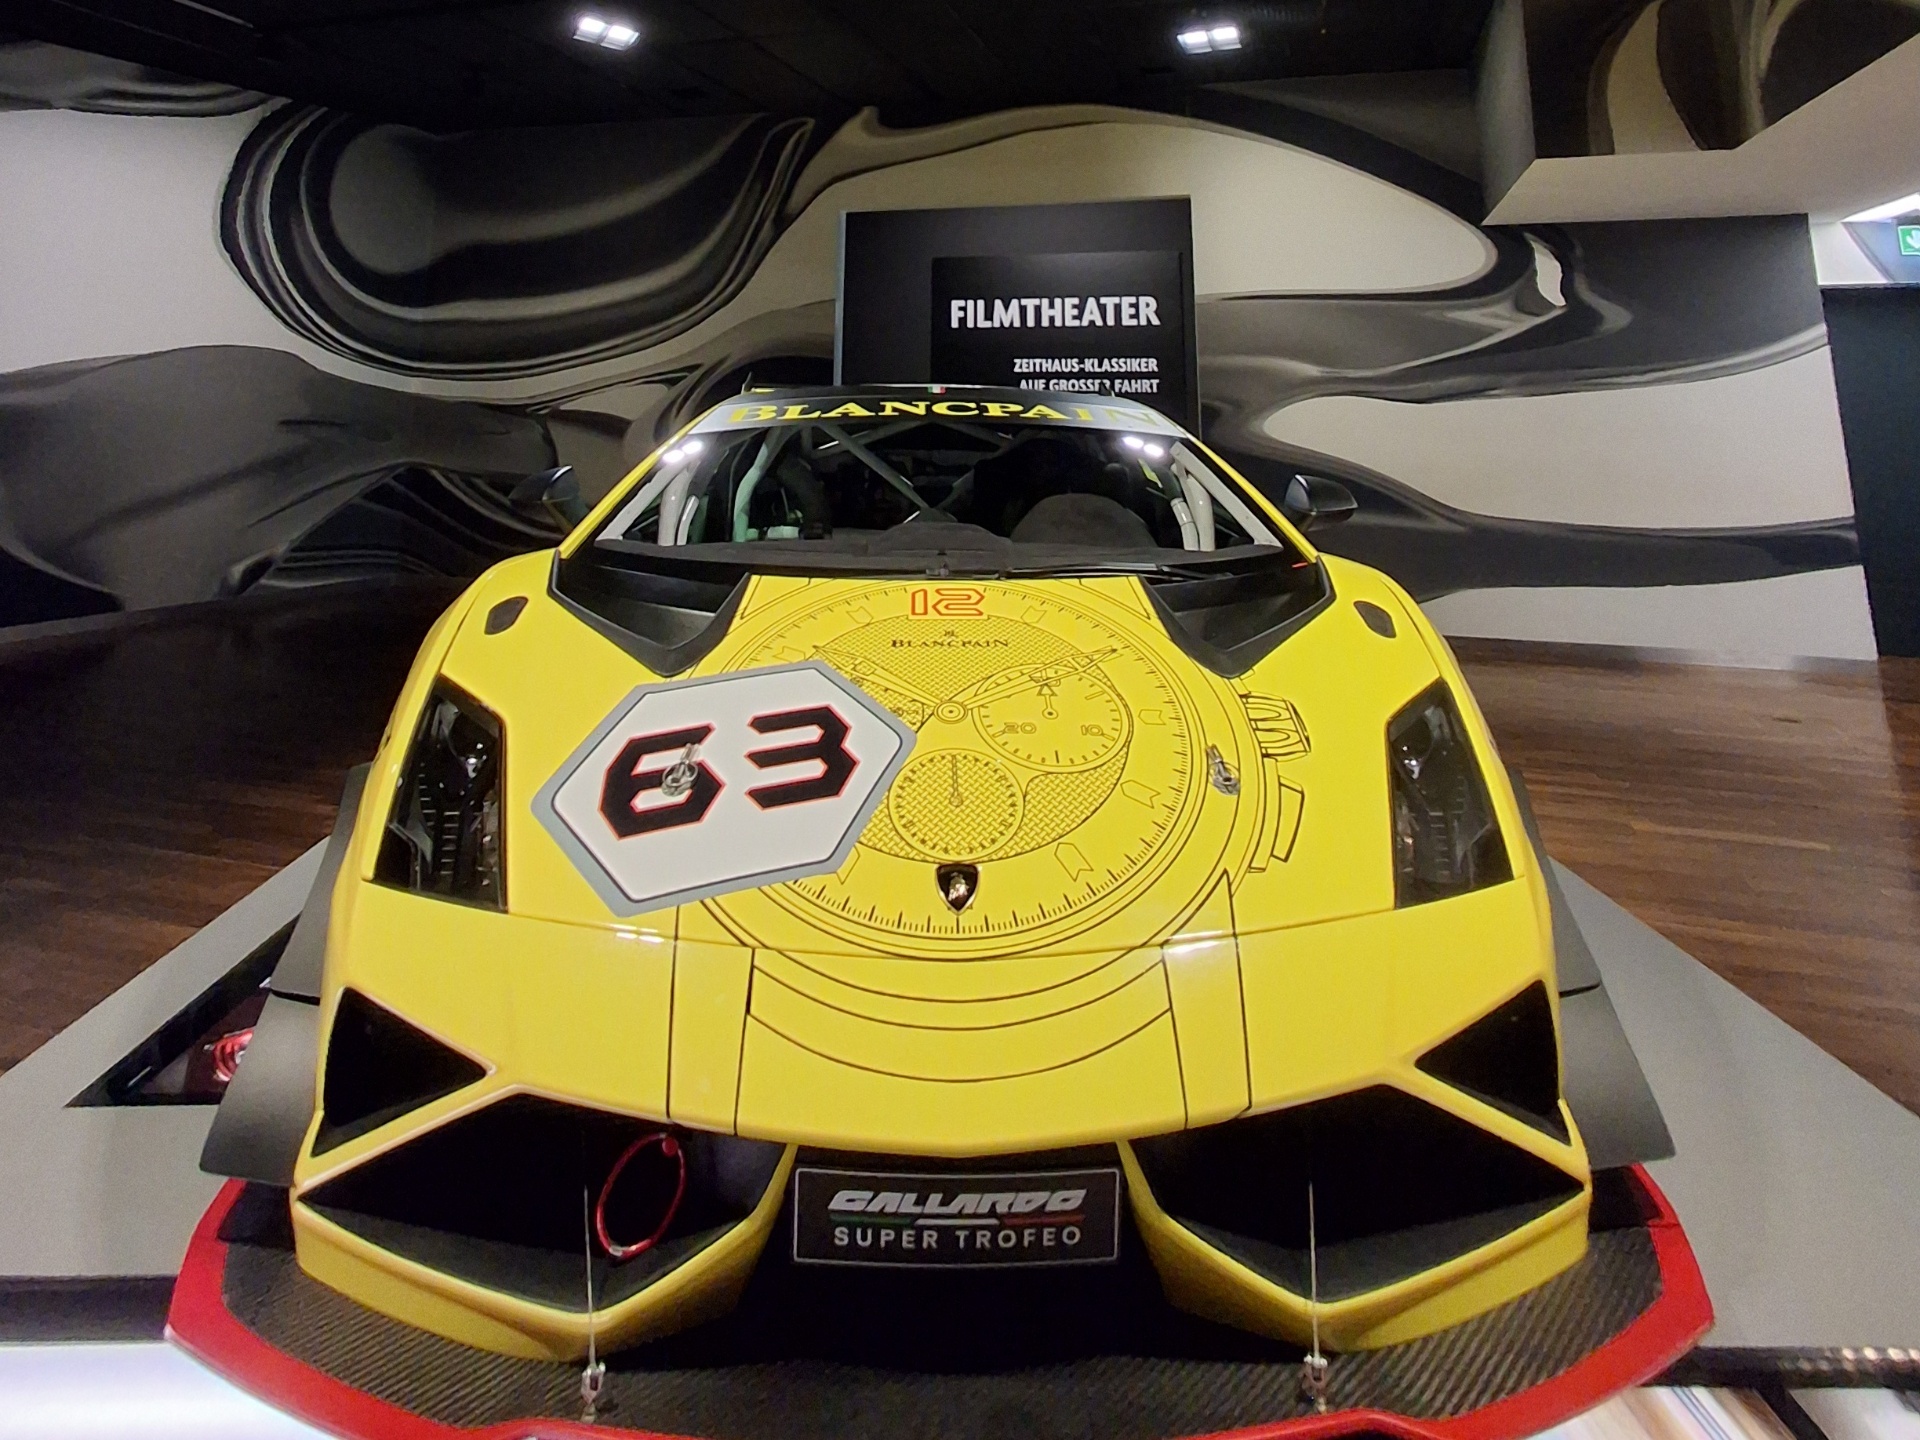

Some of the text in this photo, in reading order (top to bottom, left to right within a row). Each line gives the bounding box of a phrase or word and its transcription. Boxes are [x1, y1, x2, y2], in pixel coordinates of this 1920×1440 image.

[950, 296, 1161, 329] FILMTHEATER
[1013, 357, 1159, 373] ZEITHAUS-KLASSIKER
[1019, 379, 1046, 391] AUF
[1114, 378, 1160, 393] FAHRT
[727, 401, 1160, 427] BLANCPAIN
[911, 588, 985, 616] 12
[597, 704, 860, 841] 63
[827, 1188, 1087, 1215] GALLARDO
[833, 1226, 1082, 1250] SUPER TROFEO
